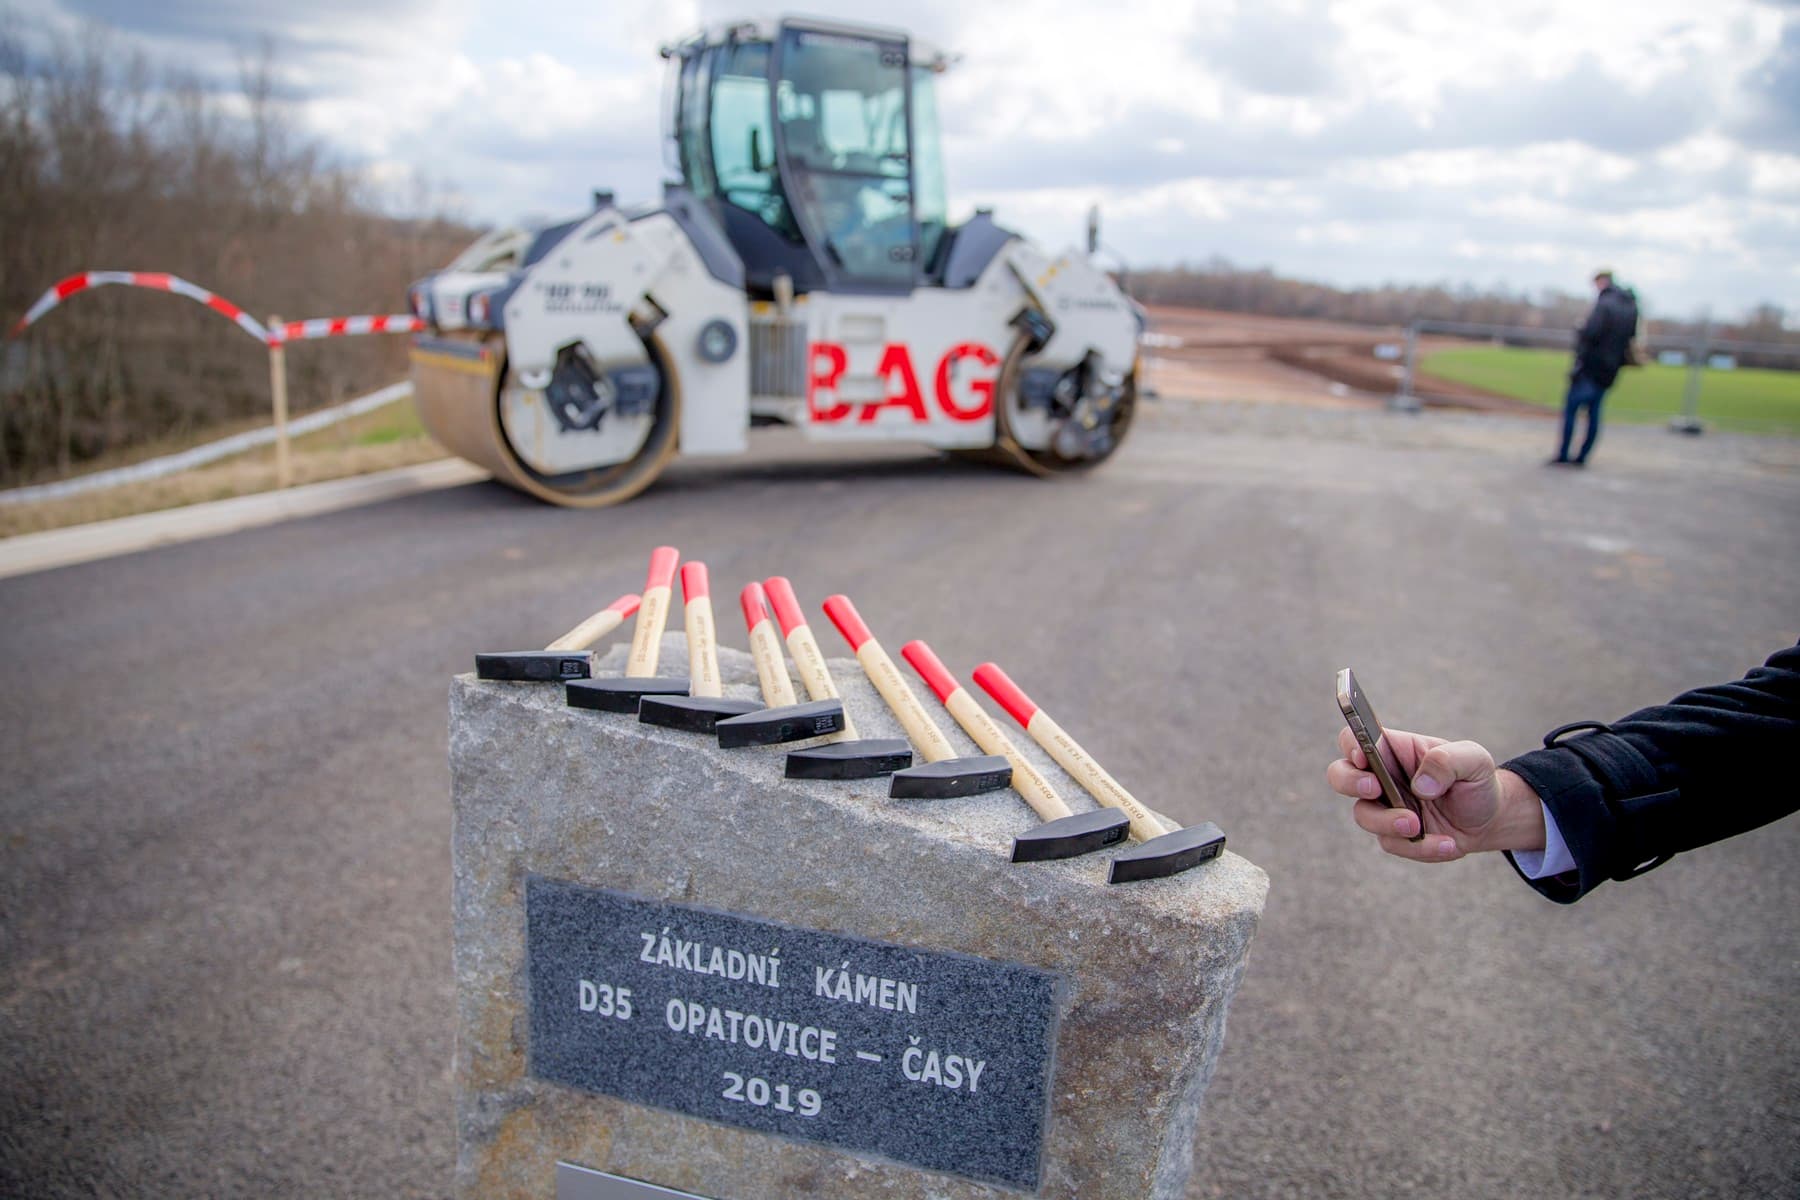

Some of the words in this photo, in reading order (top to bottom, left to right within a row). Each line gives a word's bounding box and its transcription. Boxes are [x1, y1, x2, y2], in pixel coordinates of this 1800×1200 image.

[807, 342, 1001, 424] BAG
[640, 927, 781, 988] ZÁKLADNÍ
[815, 961, 918, 1014] KÁMEN
[579, 979, 633, 1020] D35
[666, 998, 838, 1064] OPATOVICE
[902, 1036, 987, 1093] ČASY
[721, 1071, 823, 1117] 2019
